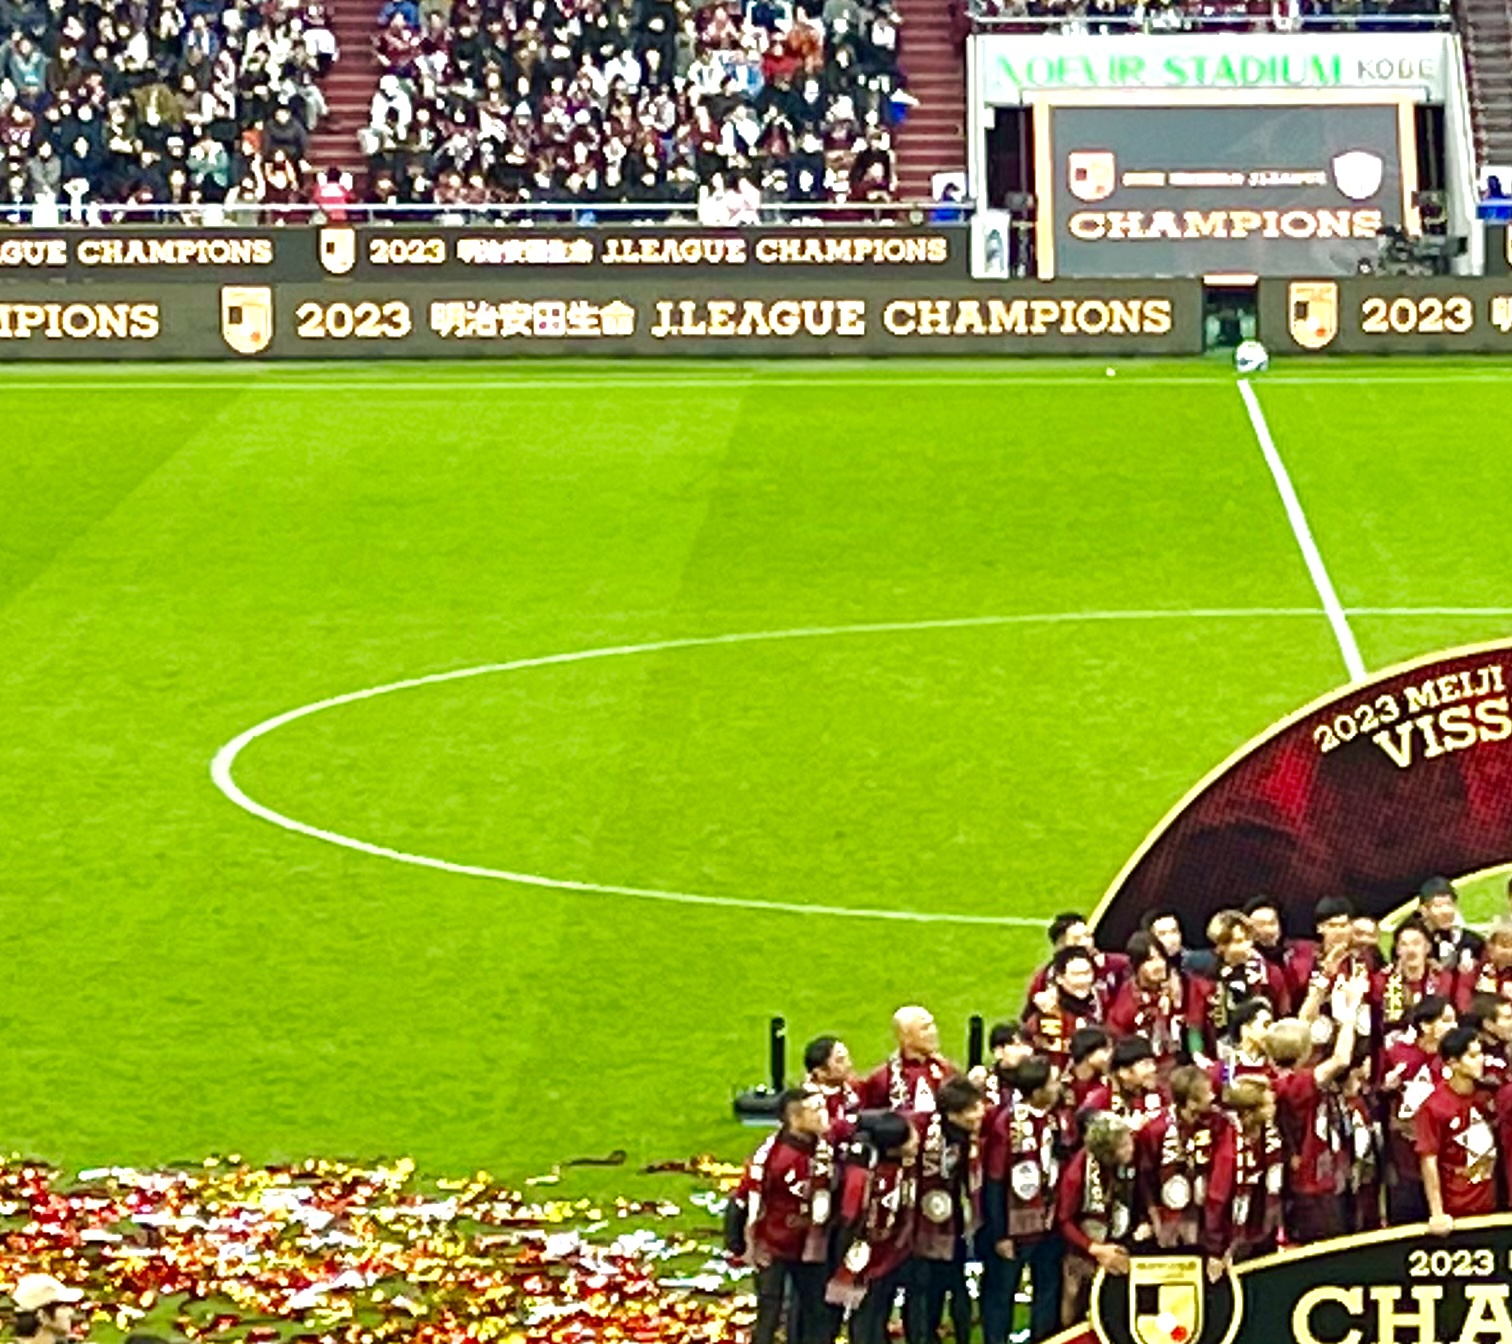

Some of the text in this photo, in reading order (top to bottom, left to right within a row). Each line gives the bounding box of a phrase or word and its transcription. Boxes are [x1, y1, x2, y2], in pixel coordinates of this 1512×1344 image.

[1162, 54, 1341, 87] STADIUM
[1068, 208, 1383, 240] CHAMPIONS
[78, 239, 273, 264] CHAMPIONS
[369, 239, 446, 264] 2023
[602, 239, 746, 263] J.LEAGUE
[756, 238, 947, 263] CHAMPIONS
[295, 299, 1171, 338] 2023 明治安田生命 J.LEAGUE CHAMPIONS
[1362, 297, 1473, 332] 2023
[1313, 700, 1400, 753] 2023
[1405, 664, 1506, 714] MEIJI
[1408, 1249, 1496, 1277] 2023
